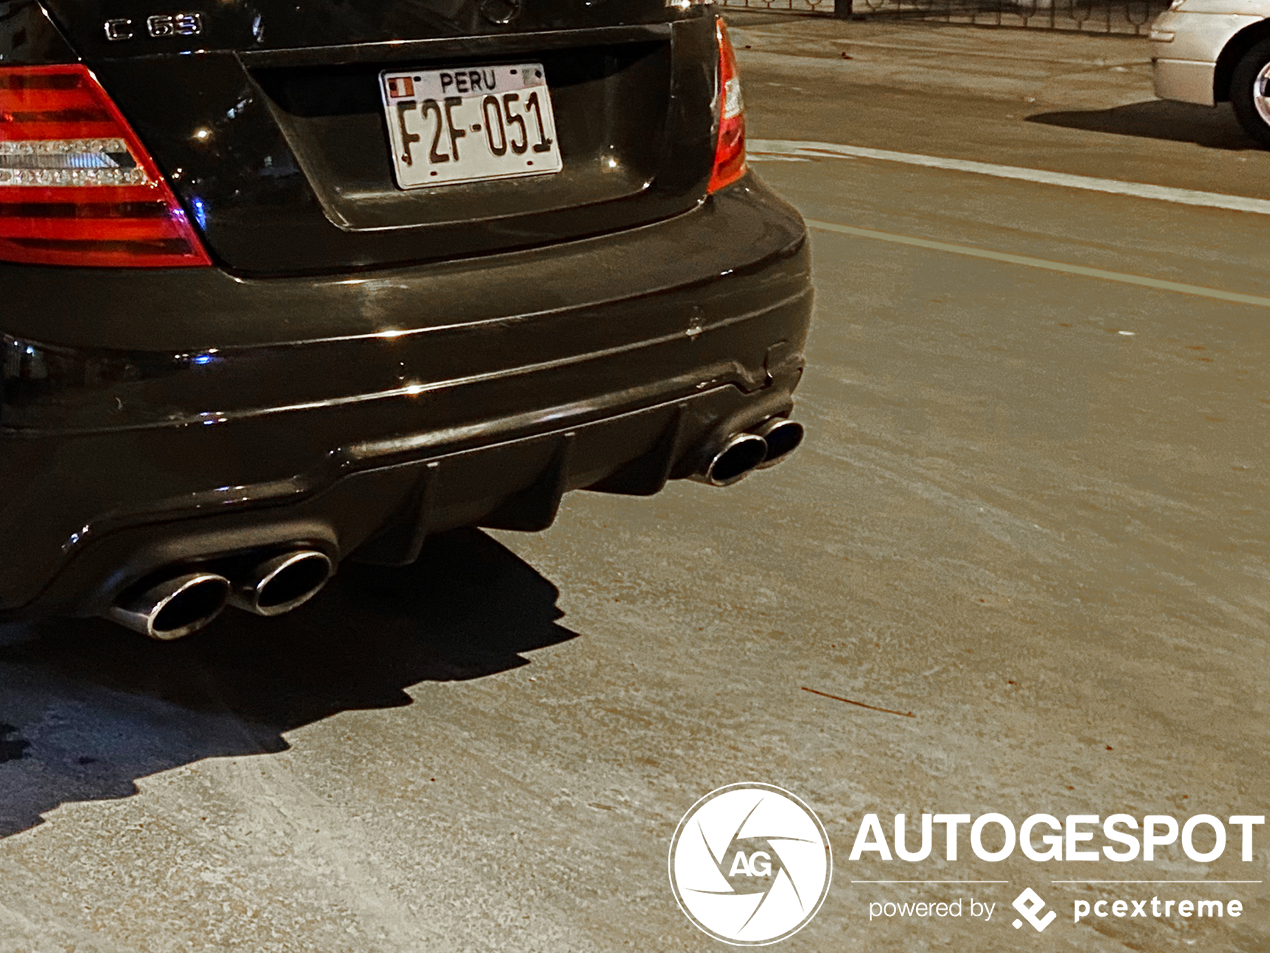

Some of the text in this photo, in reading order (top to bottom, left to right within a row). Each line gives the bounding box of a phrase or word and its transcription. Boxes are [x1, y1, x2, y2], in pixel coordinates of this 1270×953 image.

[104, 13, 203, 41] C 63
[440, 70, 497, 93] PERU
[397, 91, 553, 166] F2F-051
